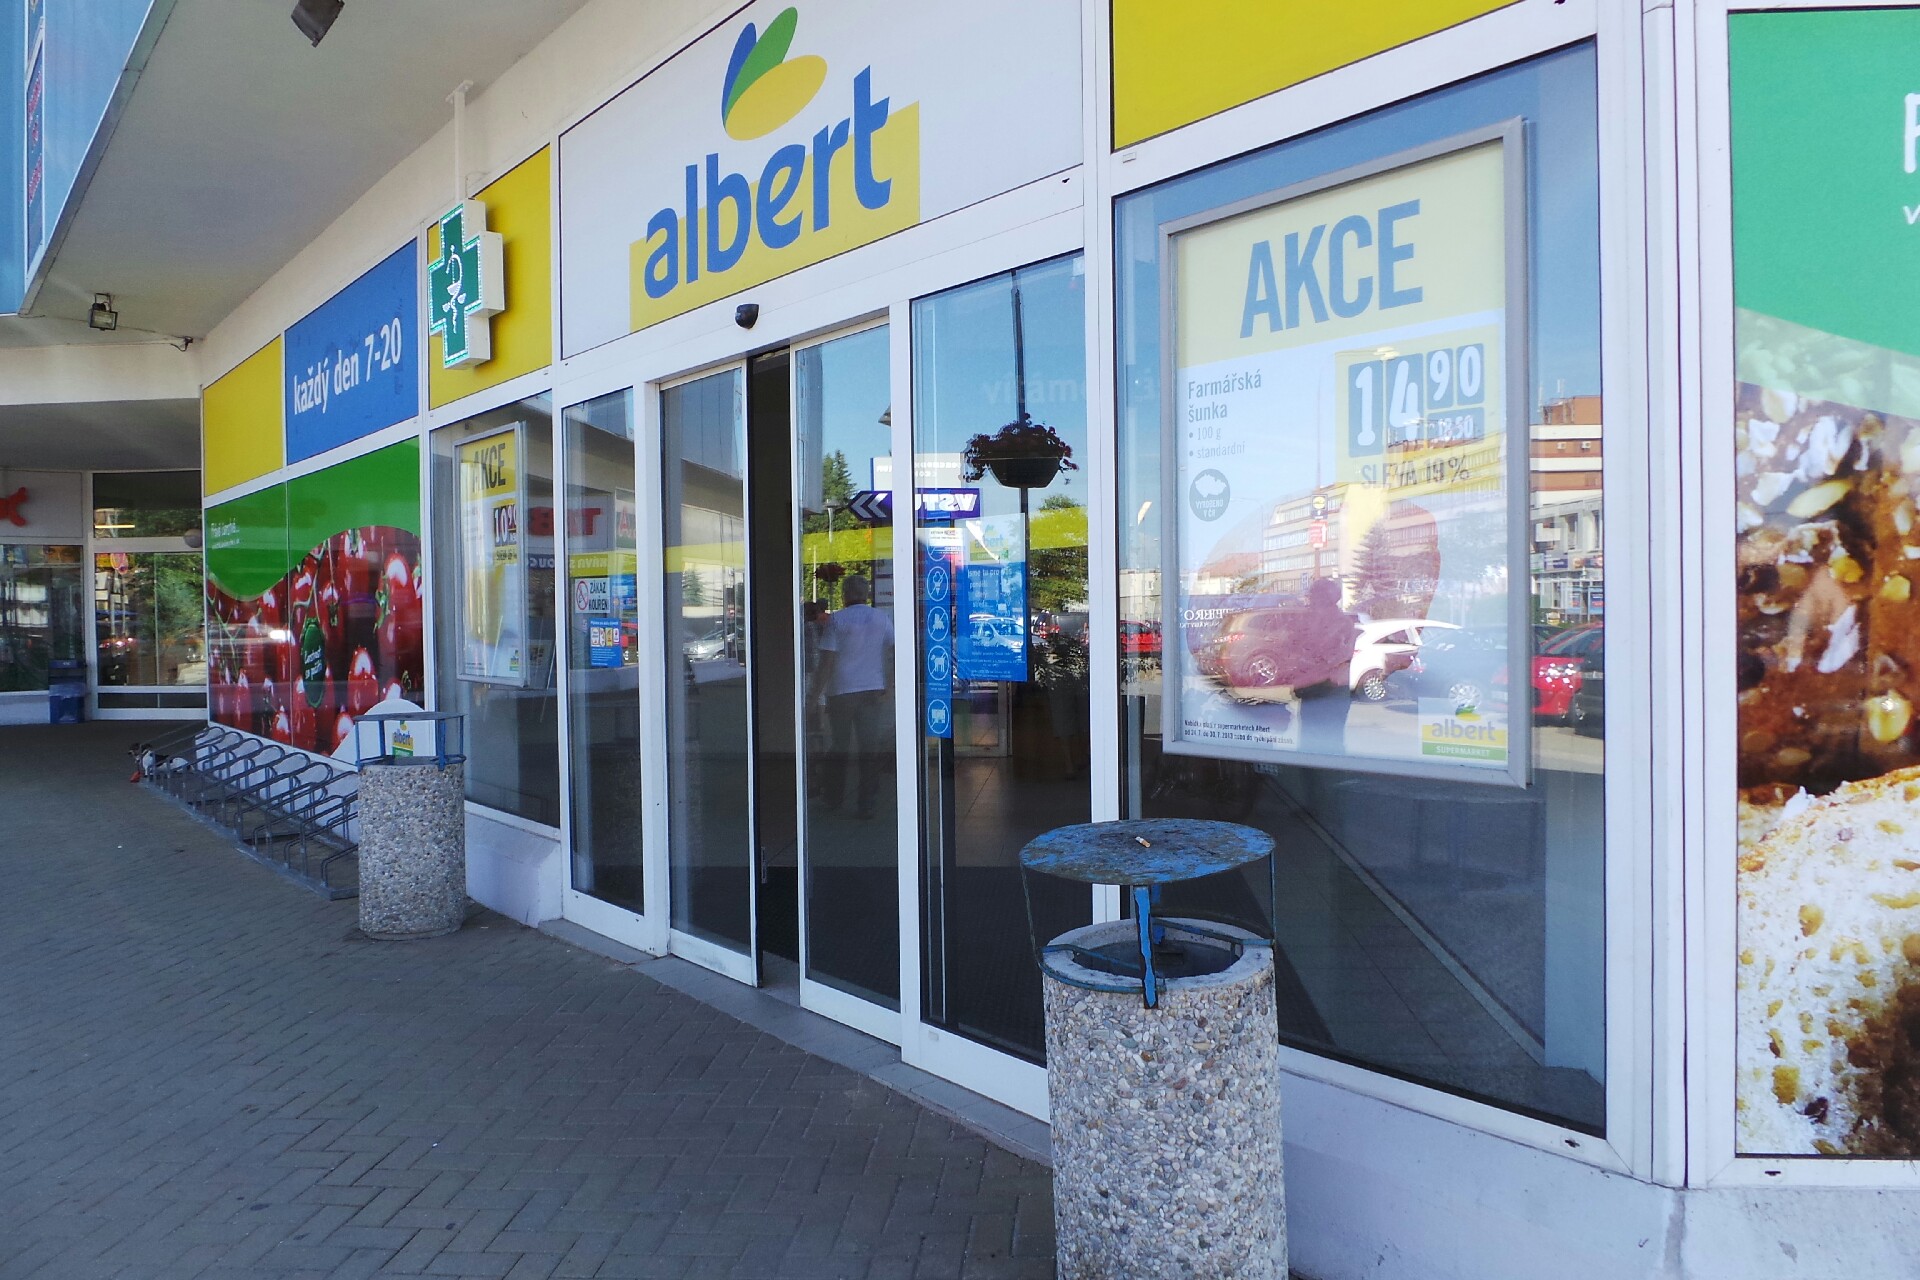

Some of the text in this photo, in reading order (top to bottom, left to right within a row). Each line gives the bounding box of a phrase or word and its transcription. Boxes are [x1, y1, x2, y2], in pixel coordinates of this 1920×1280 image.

[644, 65, 892, 299] albert
[1240, 199, 1424, 338] AKCE
[294, 318, 401, 415] každý den 7-20
[1188, 369, 1261, 399] Farmářská
[1188, 402, 1227, 423] šunka
[1197, 426, 1221, 440] 100 g
[1197, 441, 1245, 459] standardní
[473, 443, 506, 494] AKCE
[590, 580, 606, 594] ZÁKAZ
[1431, 719, 1496, 741] albert
[1435, 745, 1491, 757] SUPERMARKET
